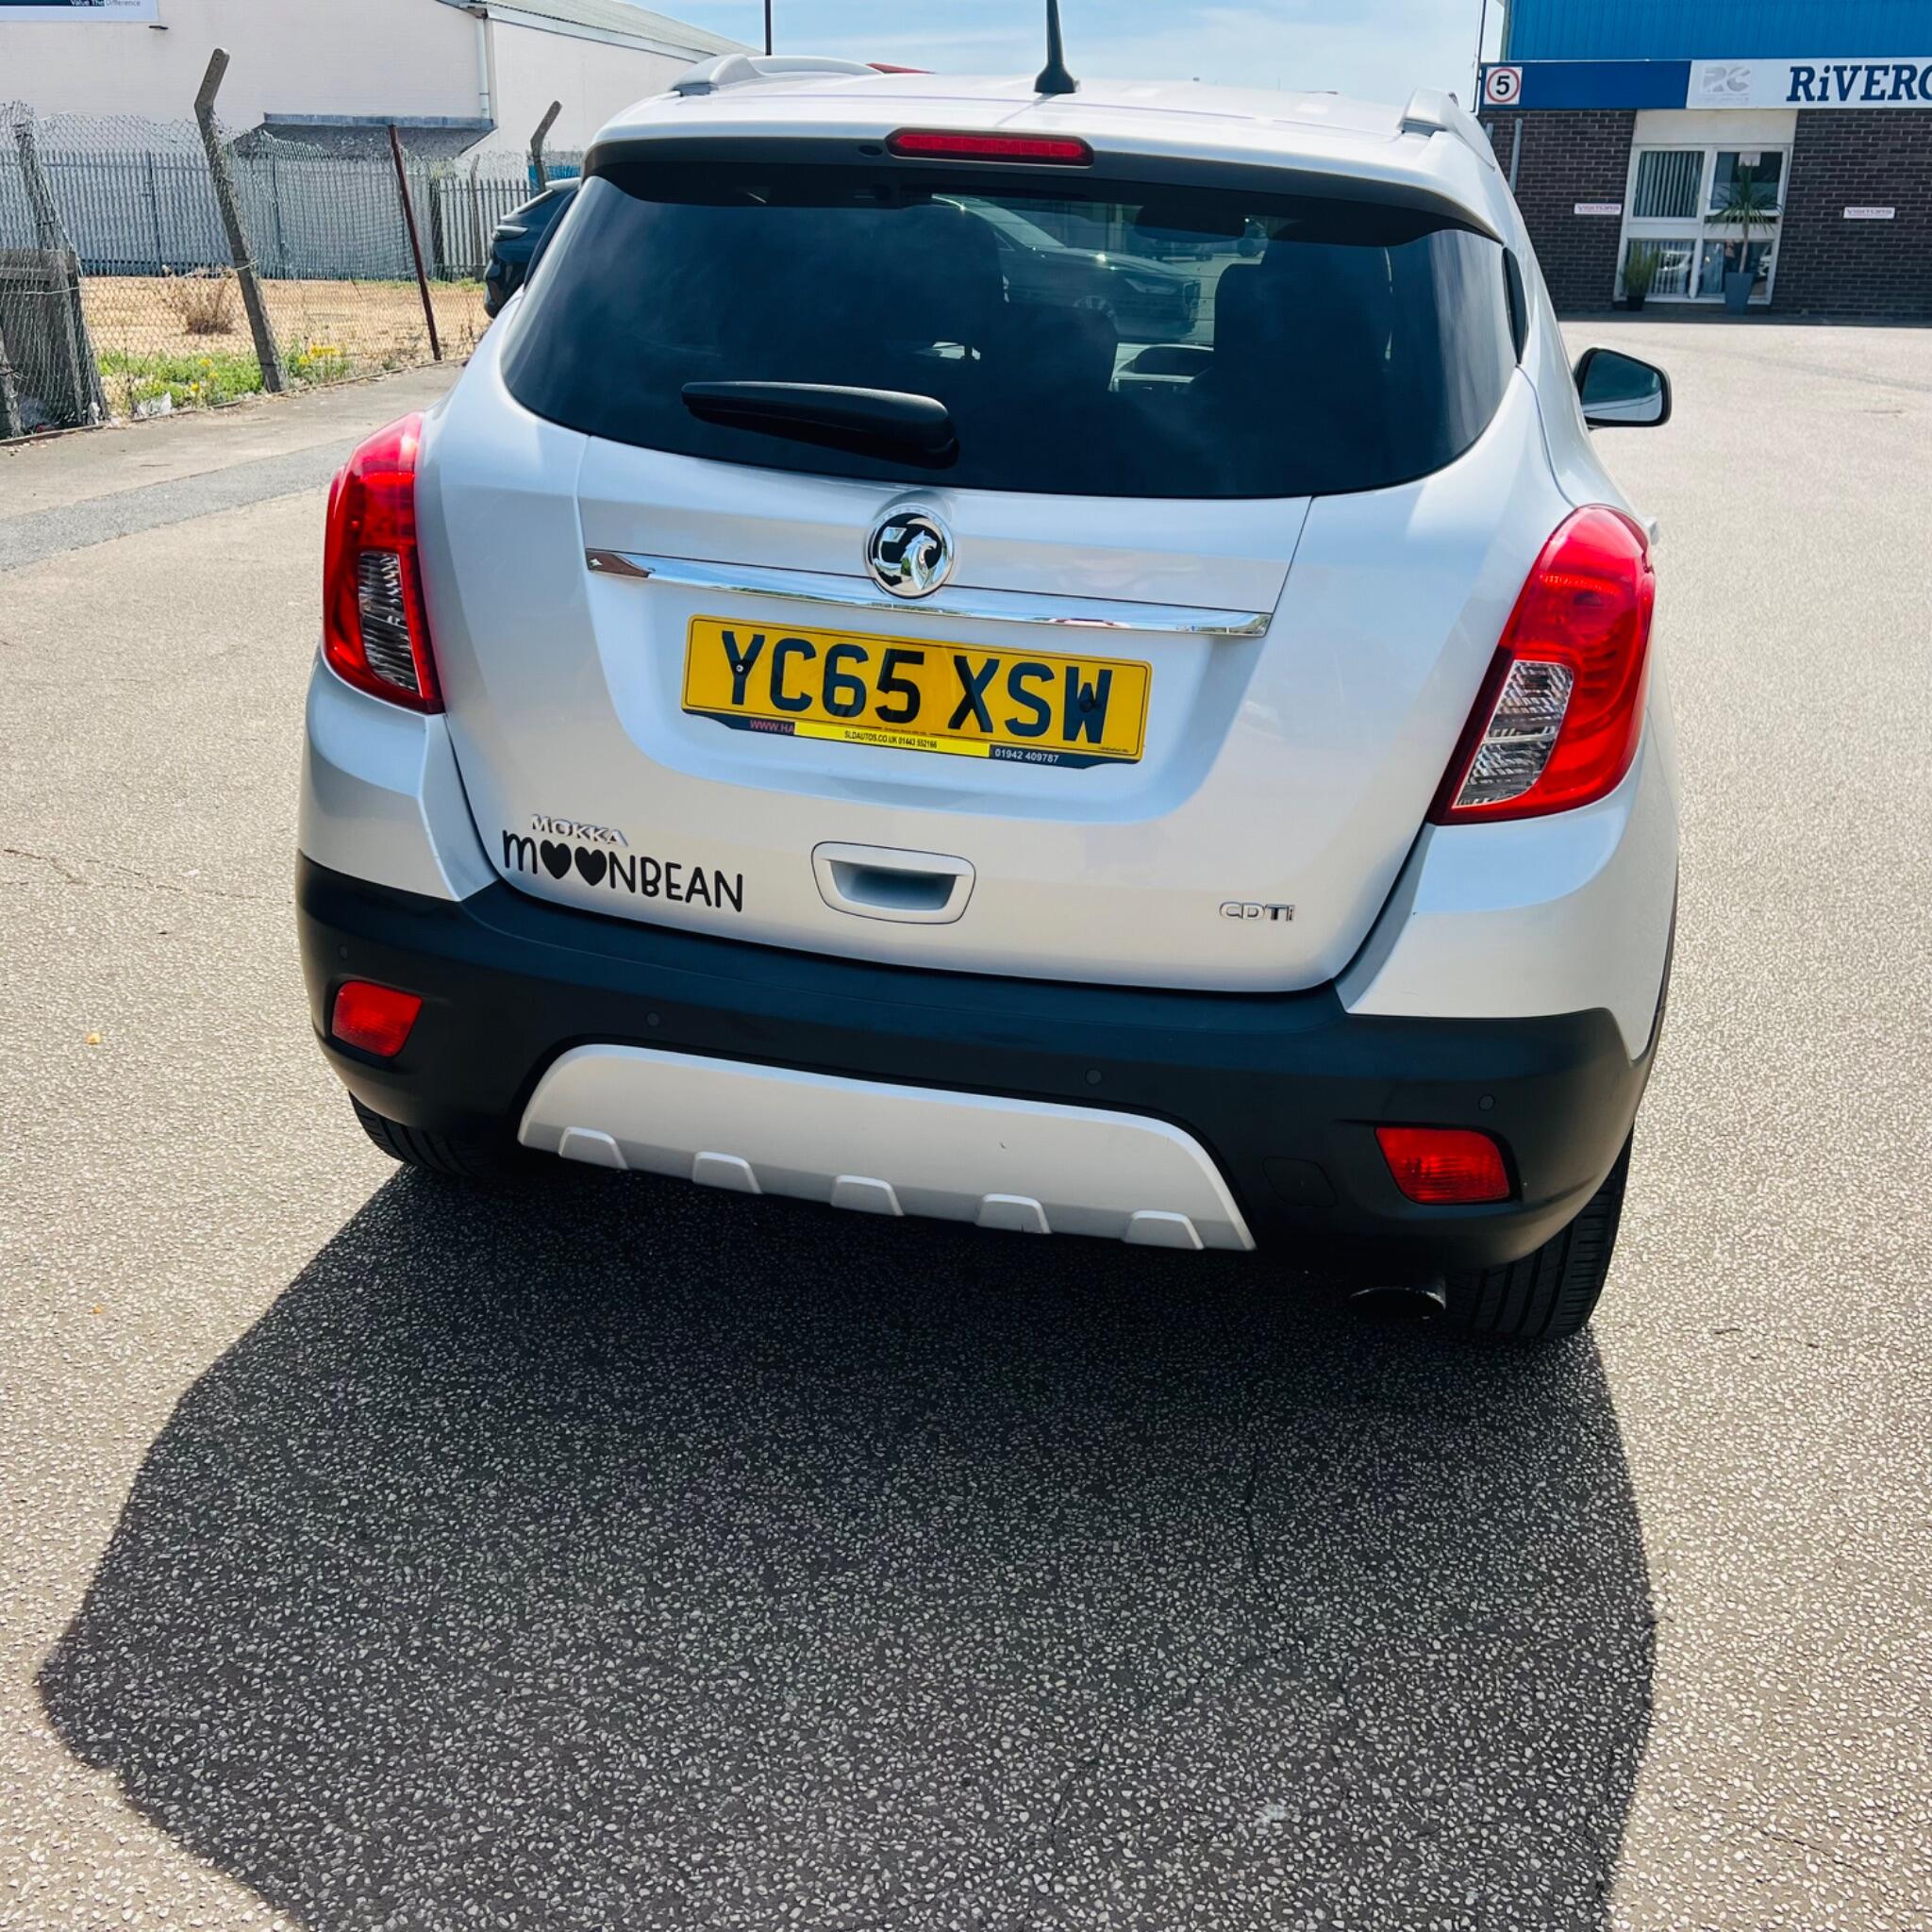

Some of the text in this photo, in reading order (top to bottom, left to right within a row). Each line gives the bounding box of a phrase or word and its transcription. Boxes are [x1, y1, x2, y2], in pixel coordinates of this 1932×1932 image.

[1495, 75, 1510, 95] 5
[721, 630, 1113, 743] YC65 XSW
[994, 748, 1059, 764] 01942 409787
[530, 814, 629, 847] MOKKA
